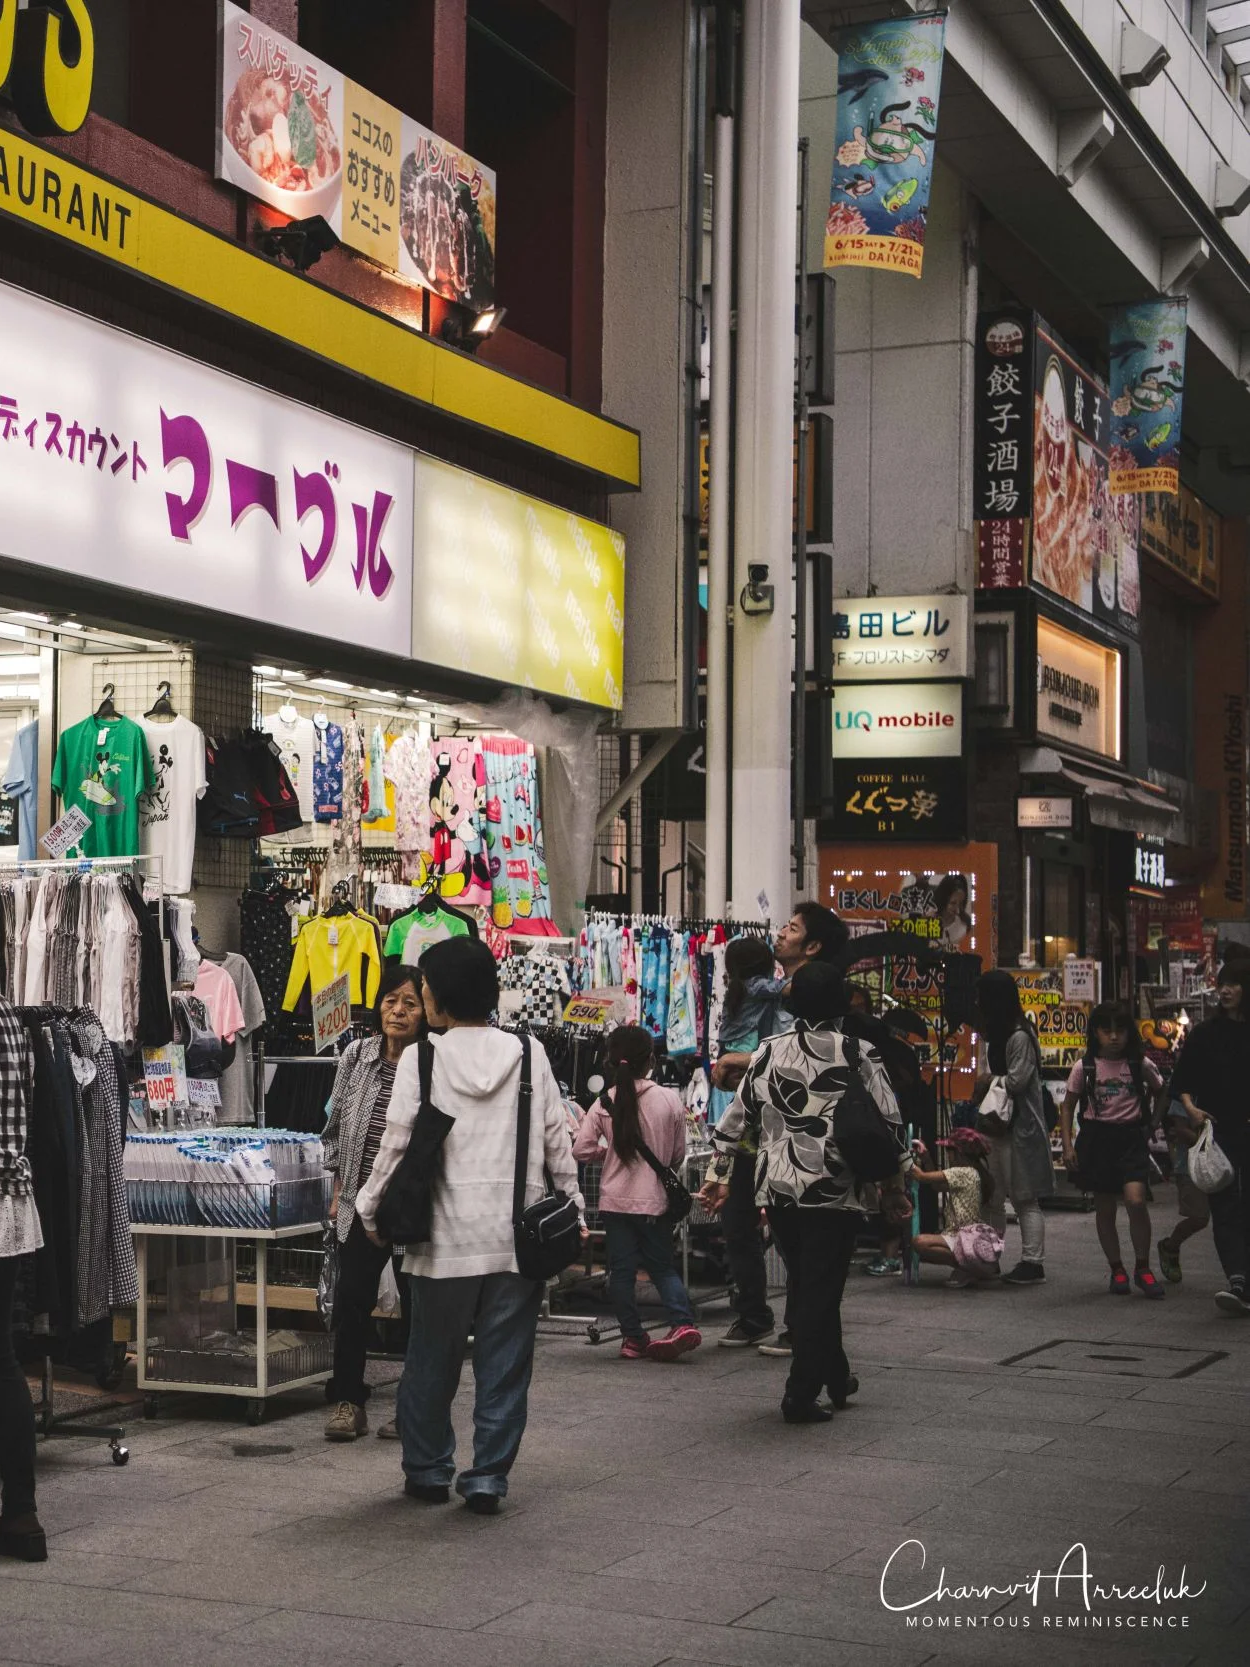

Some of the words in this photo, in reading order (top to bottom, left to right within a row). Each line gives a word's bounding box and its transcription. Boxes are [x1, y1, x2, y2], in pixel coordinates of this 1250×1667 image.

[237, 22, 333, 113] スパゲッティ
[351, 111, 393, 157] ココスの
[347, 148, 396, 208] おすすめ
[415, 135, 484, 201] ハンバーグ
[350, 199, 391, 237] メニュー
[835, 240, 864, 250] 6/15
[889, 241, 913, 255] 7/21
[984, 363, 1023, 513] 餃子酒場
[159, 405, 395, 599] マーブル
[566, 513, 602, 588] marble
[565, 589, 600, 667] marble
[835, 710, 873, 732] UQ
[878, 712, 955, 728] mobile
[857, 775, 894, 783] COFFEE
[901, 775, 928, 783] HALL
